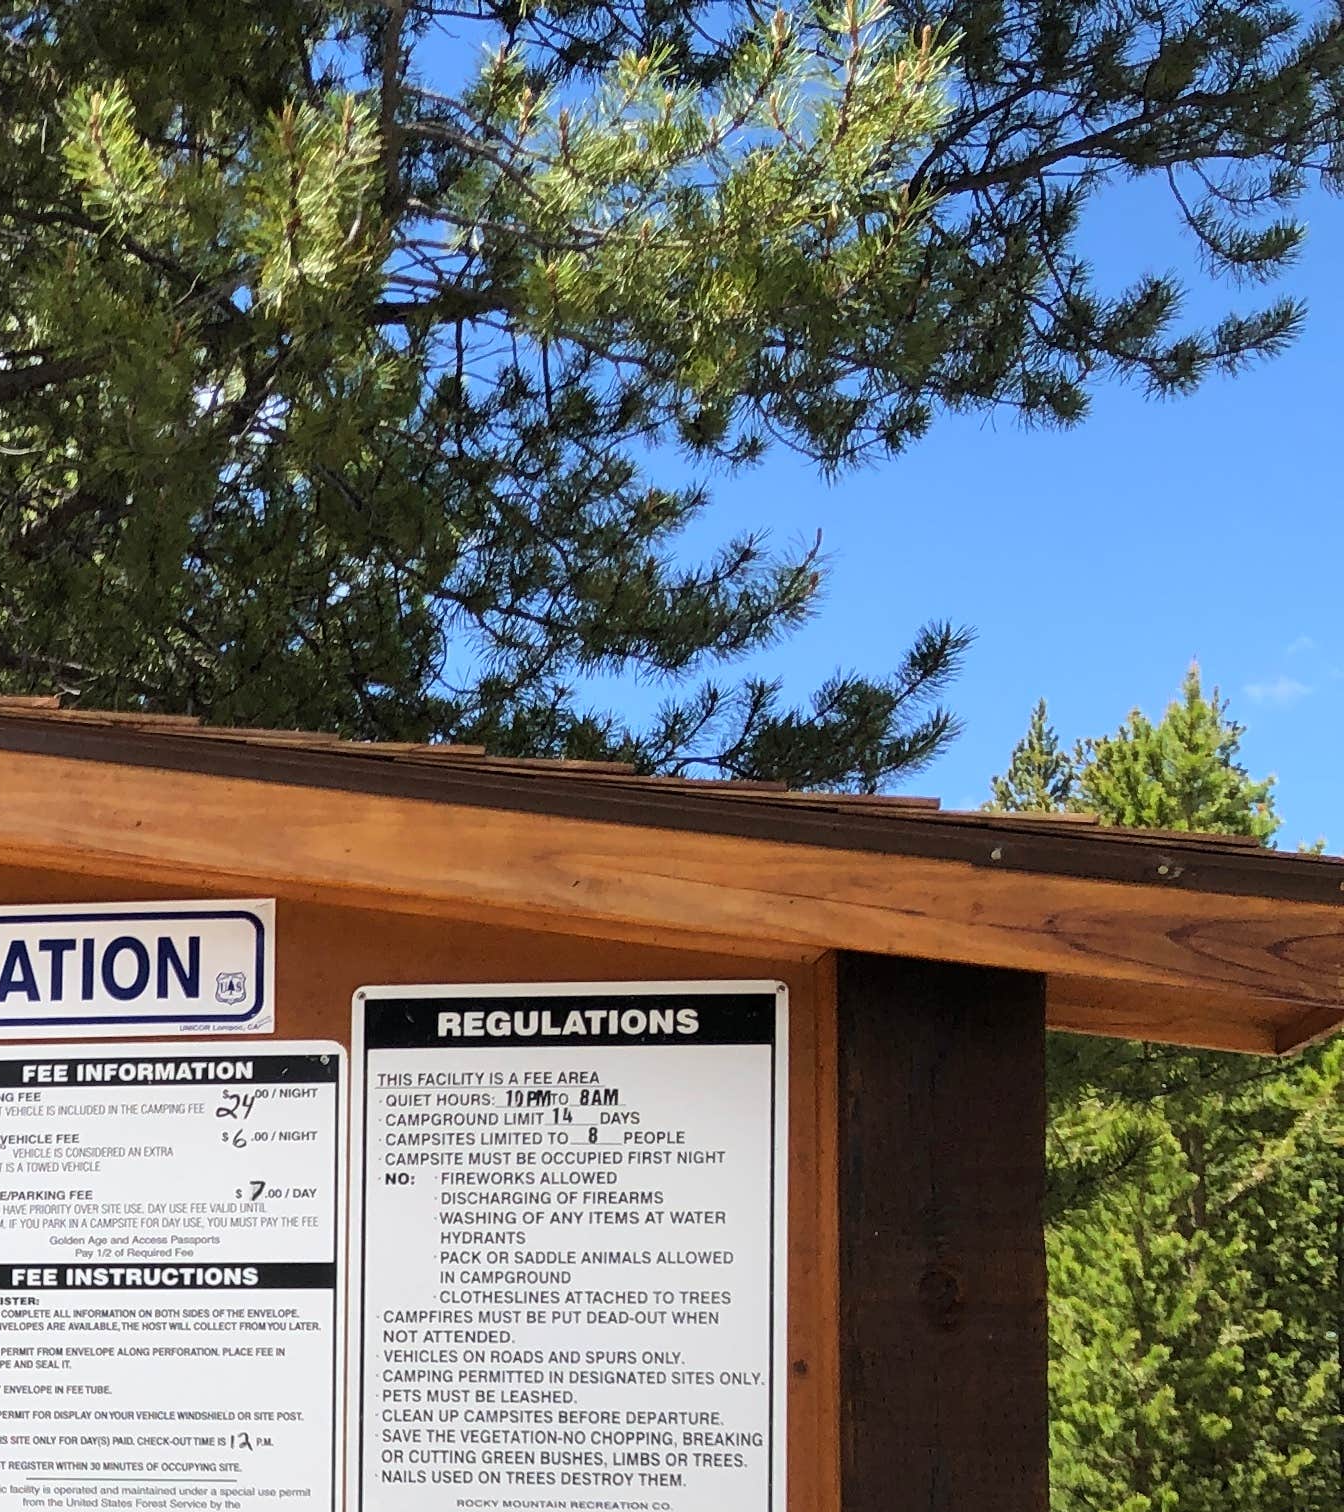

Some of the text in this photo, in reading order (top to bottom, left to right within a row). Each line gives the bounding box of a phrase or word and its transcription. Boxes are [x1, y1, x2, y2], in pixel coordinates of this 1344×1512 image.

[437, 1008, 698, 1036] REGULATIONS
[22, 1061, 253, 1083] FEE INFORMATION
[377, 1071, 599, 1086] THIS FACILITY IS A FEE AREA
[17, 1091, 41, 1102] FEE
[385, 1093, 497, 1107] QUIET HOURS:
[385, 1108, 640, 1126] CAMPGROUND LIMIT 14 DAYS
[0, 1134, 52, 1145] VEHICLE
[55, 1133, 79, 1144] FEE
[385, 1172, 414, 1185] NO:
[69, 1189, 93, 1200] FEE
[11, 1267, 258, 1286] FEE INSTRUCTIONS
[382, 1389, 577, 1403] PETS MUST BE LEASHED.
